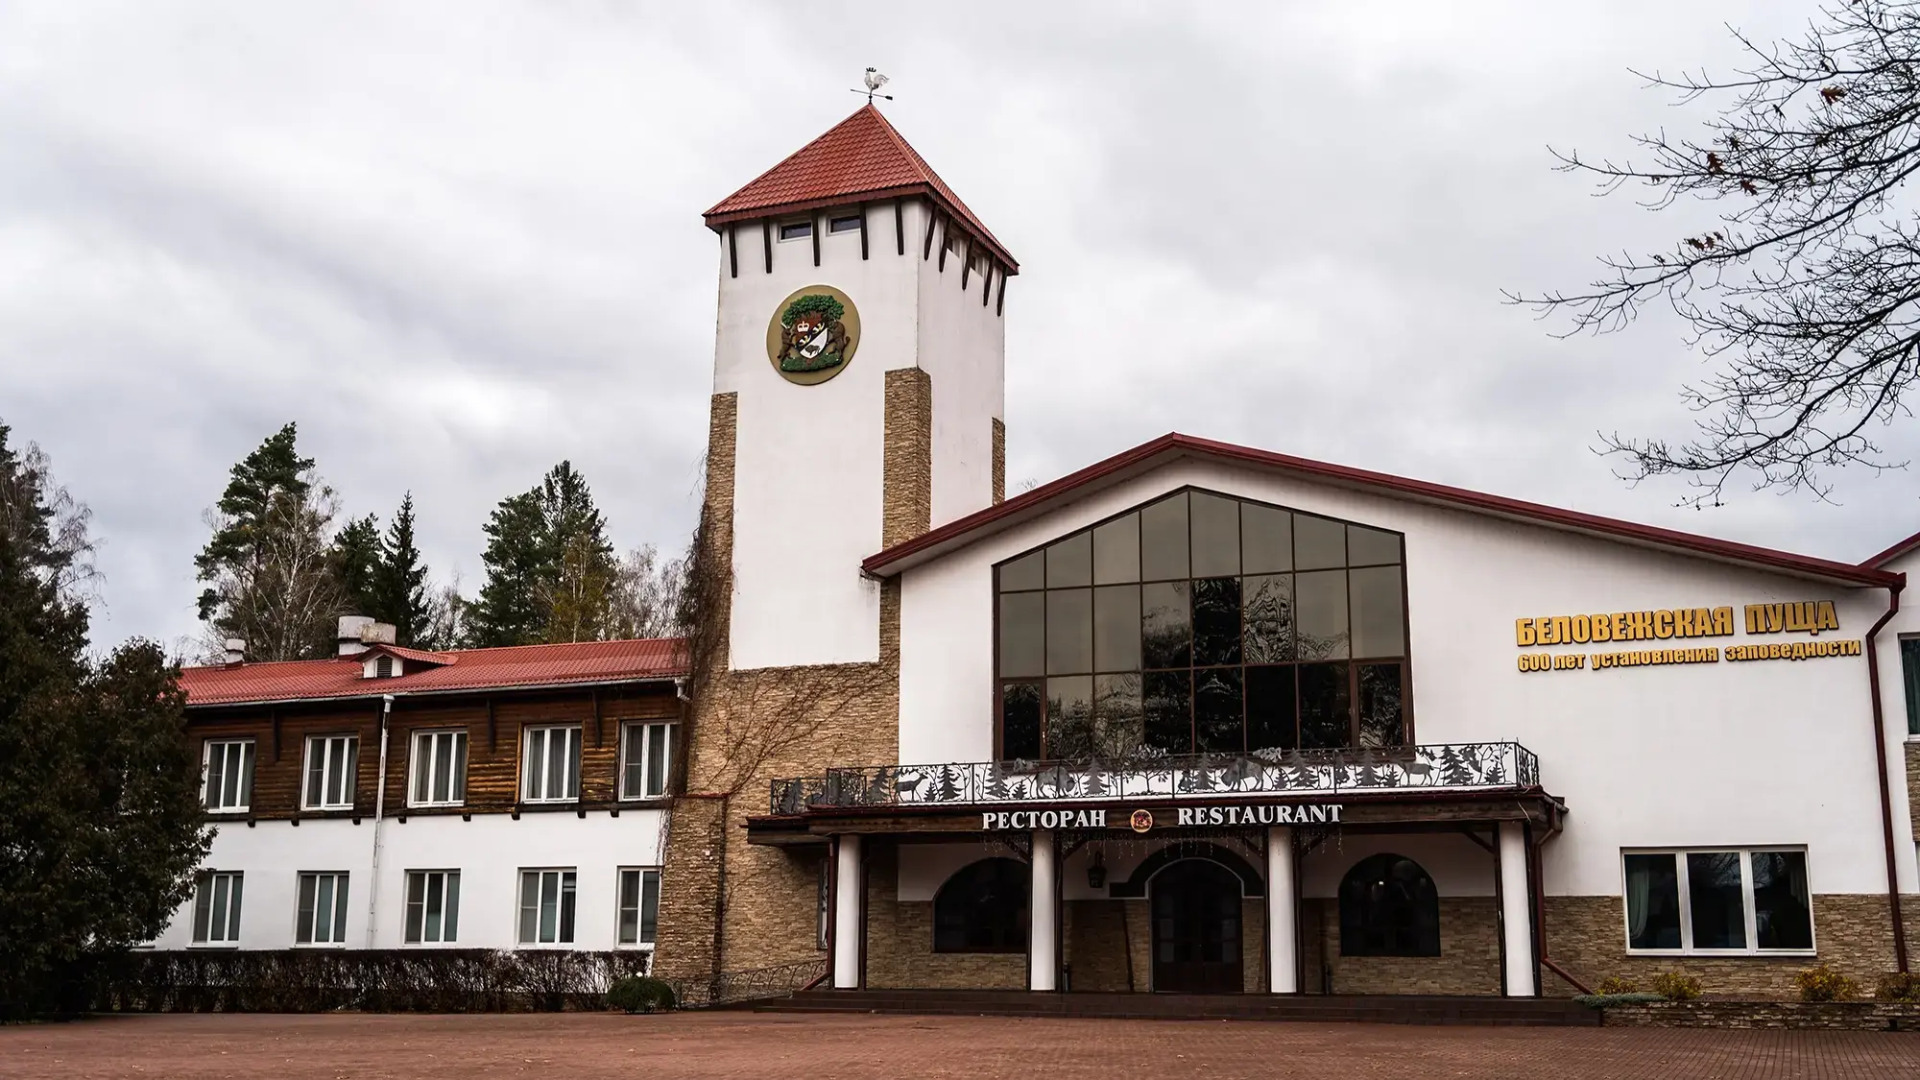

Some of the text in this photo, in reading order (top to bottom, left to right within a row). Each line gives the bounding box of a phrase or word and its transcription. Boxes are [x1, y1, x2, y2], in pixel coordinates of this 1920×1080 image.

[1516, 600, 1839, 646] БЕЛОВЕЖСКАЯ ПУЩА
[1518, 640, 1861, 672] 600 лет установления заповедности
[982, 809, 1107, 830] РЕСТОРАН
[1177, 804, 1343, 826] RESTAURANT
